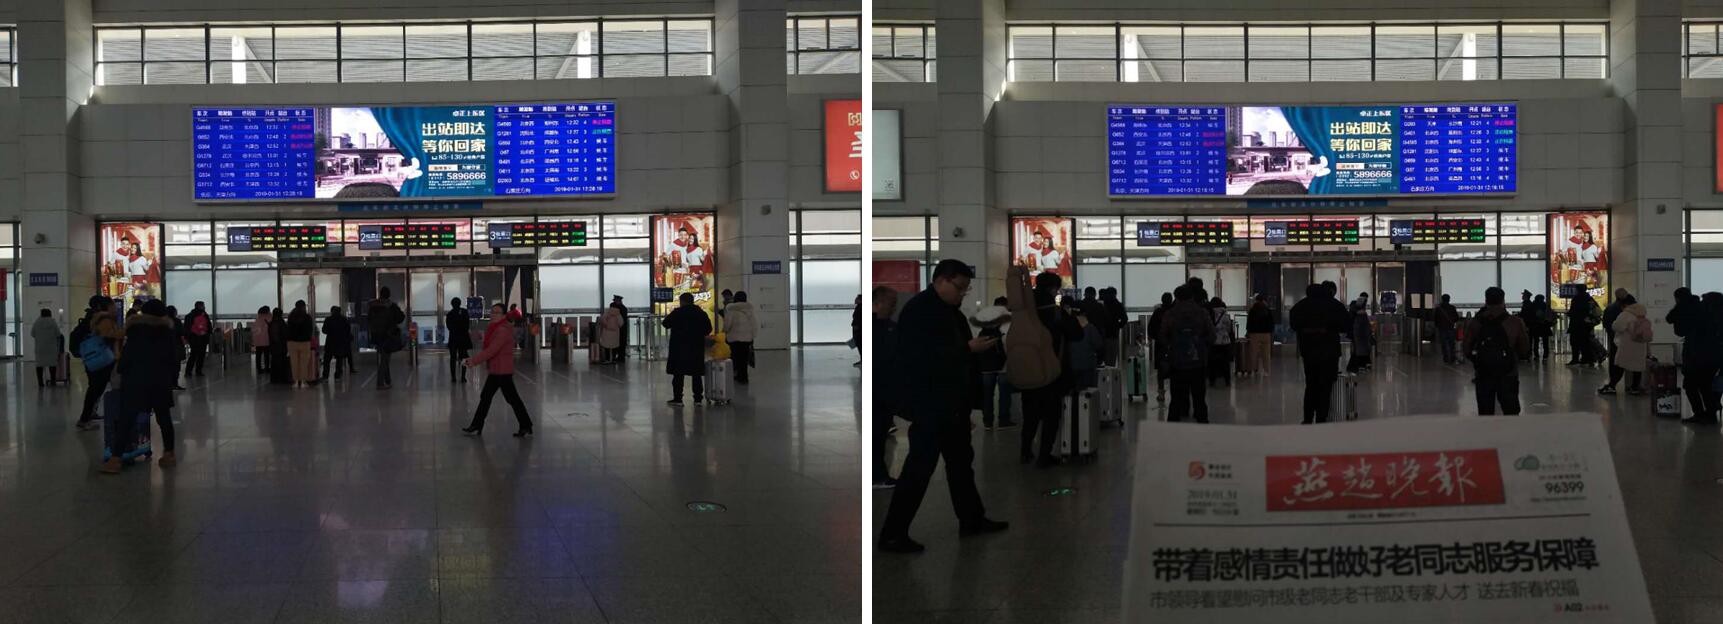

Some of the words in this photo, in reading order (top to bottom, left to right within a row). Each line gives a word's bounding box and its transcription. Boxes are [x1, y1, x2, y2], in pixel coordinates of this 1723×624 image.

[422, 122, 485, 136] 出站即达
[1330, 122, 1391, 135] 出站即达
[422, 139, 485, 152] 等你回家
[1330, 139, 1392, 151] 等你回家
[447, 172, 486, 180] 5896666
[1545, 481, 1584, 494] 96399
[1152, 537, 1600, 582] 带着感情责任做好老同志服务保障
[1150, 584, 1470, 608] 市领导看望慰问市级老同志老干部及专家人才
[1478, 578, 1580, 600] 送去新春祝福
[1565, 602, 1582, 612] A02
